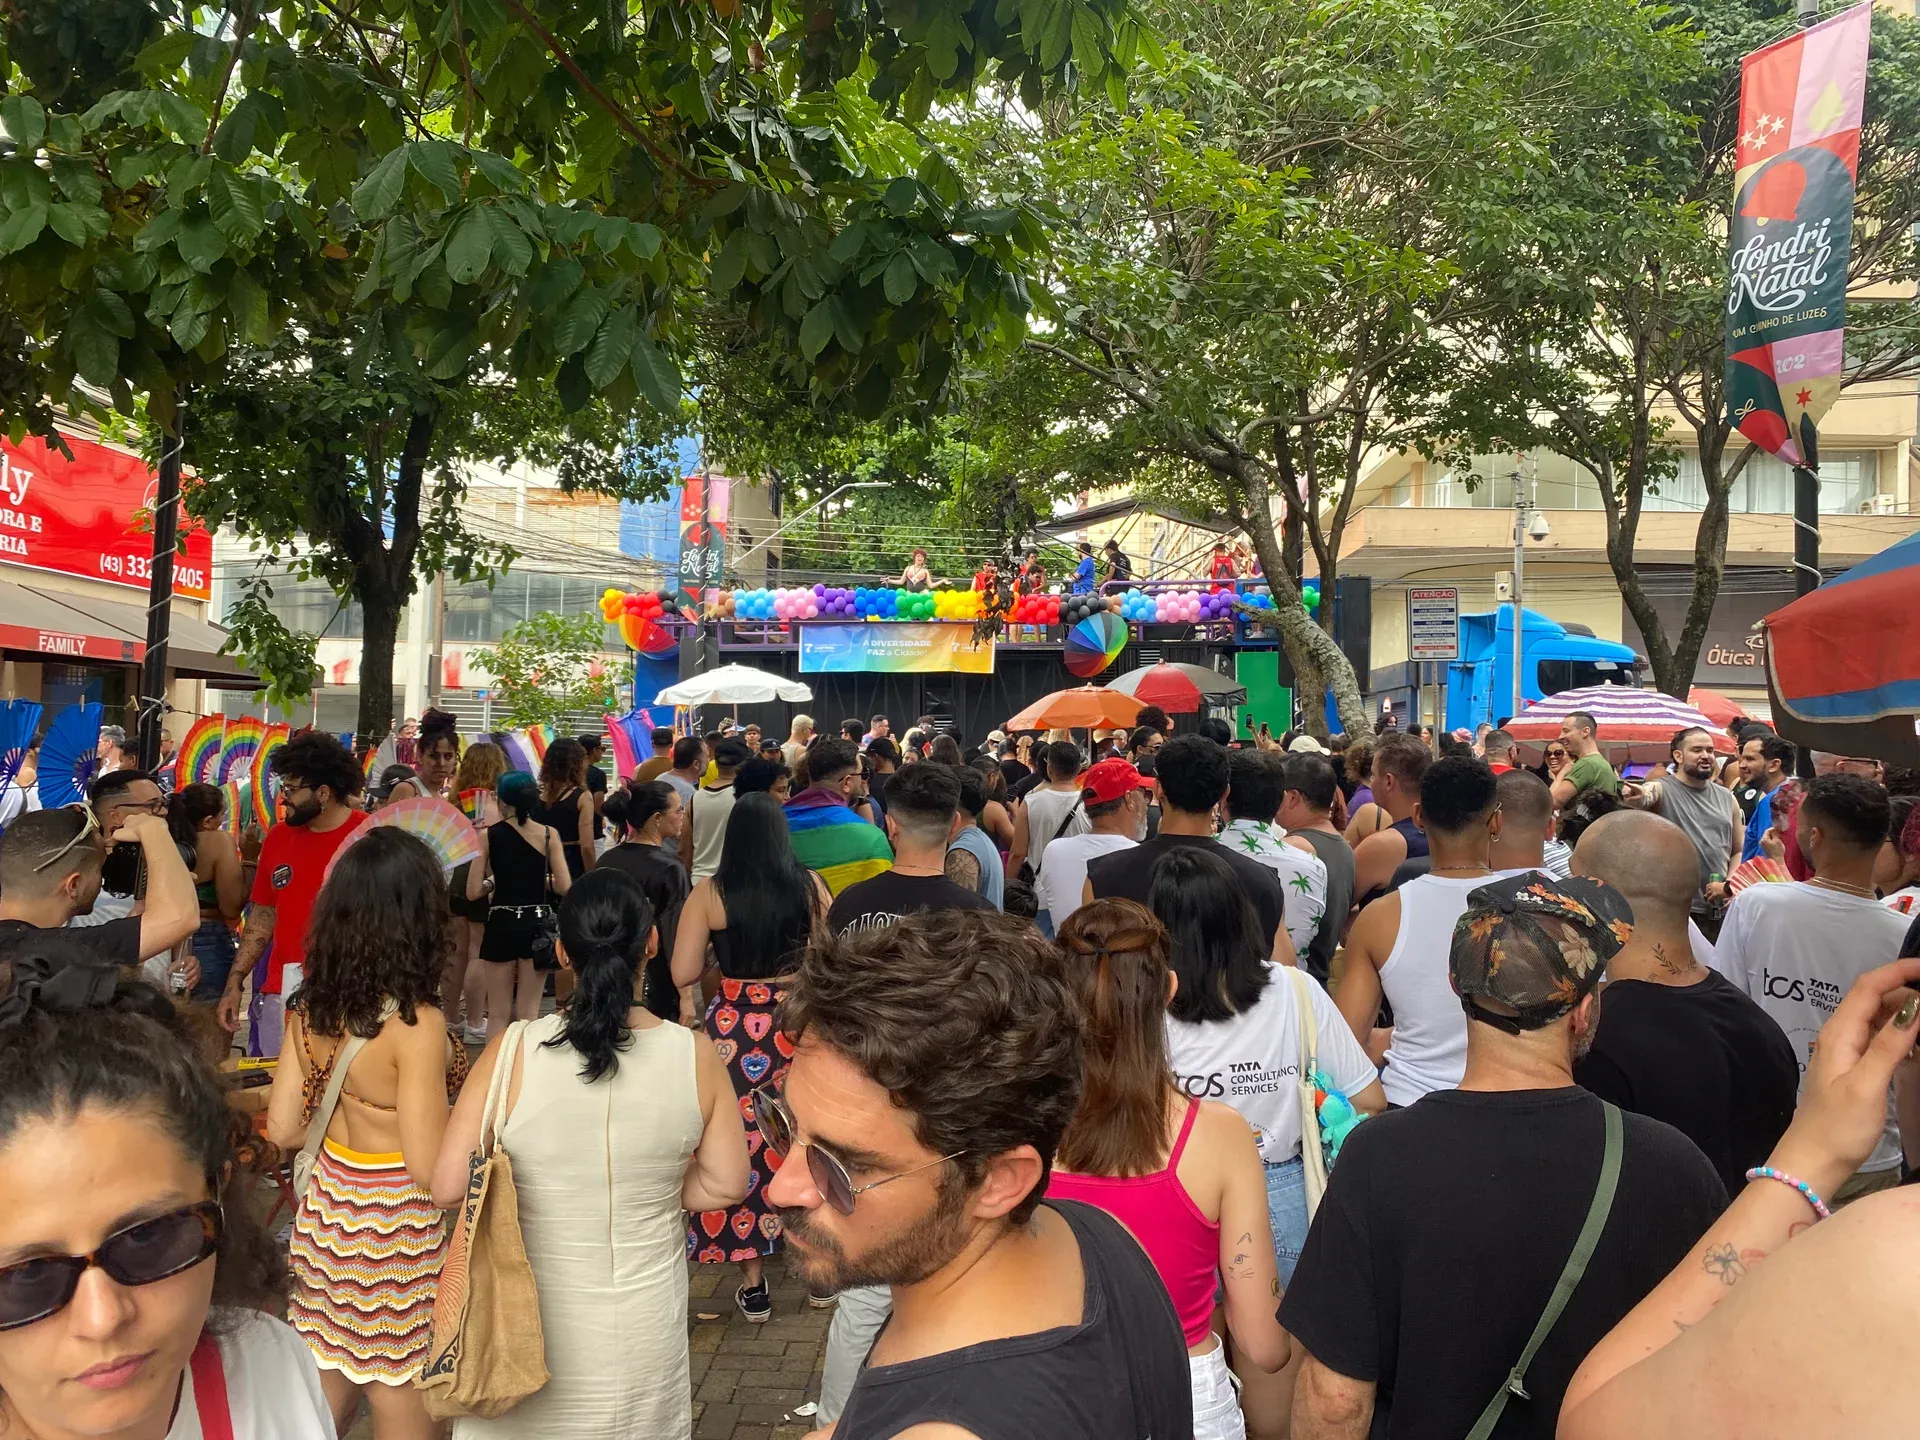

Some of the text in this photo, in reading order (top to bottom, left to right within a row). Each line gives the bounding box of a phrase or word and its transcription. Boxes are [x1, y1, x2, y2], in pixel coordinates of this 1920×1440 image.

[1731, 217, 1832, 287] Londri
[1728, 245, 1831, 313] Natal
[1732, 326, 1746, 338] UM
[1782, 314, 1794, 325] DE
[1797, 307, 1827, 321] LUZES
[0, 508, 42, 533] RA E
[100, 553, 123, 577] (43)
[39, 635, 86, 655] FAMILY
[1707, 644, 1755, 665] Ótica
[1809, 978, 1840, 993] TATA
[1229, 1061, 1261, 1073] TATA
[1230, 1065, 1299, 1084] CONSULTANCY
[1231, 1082, 1278, 1096] SERVICES
